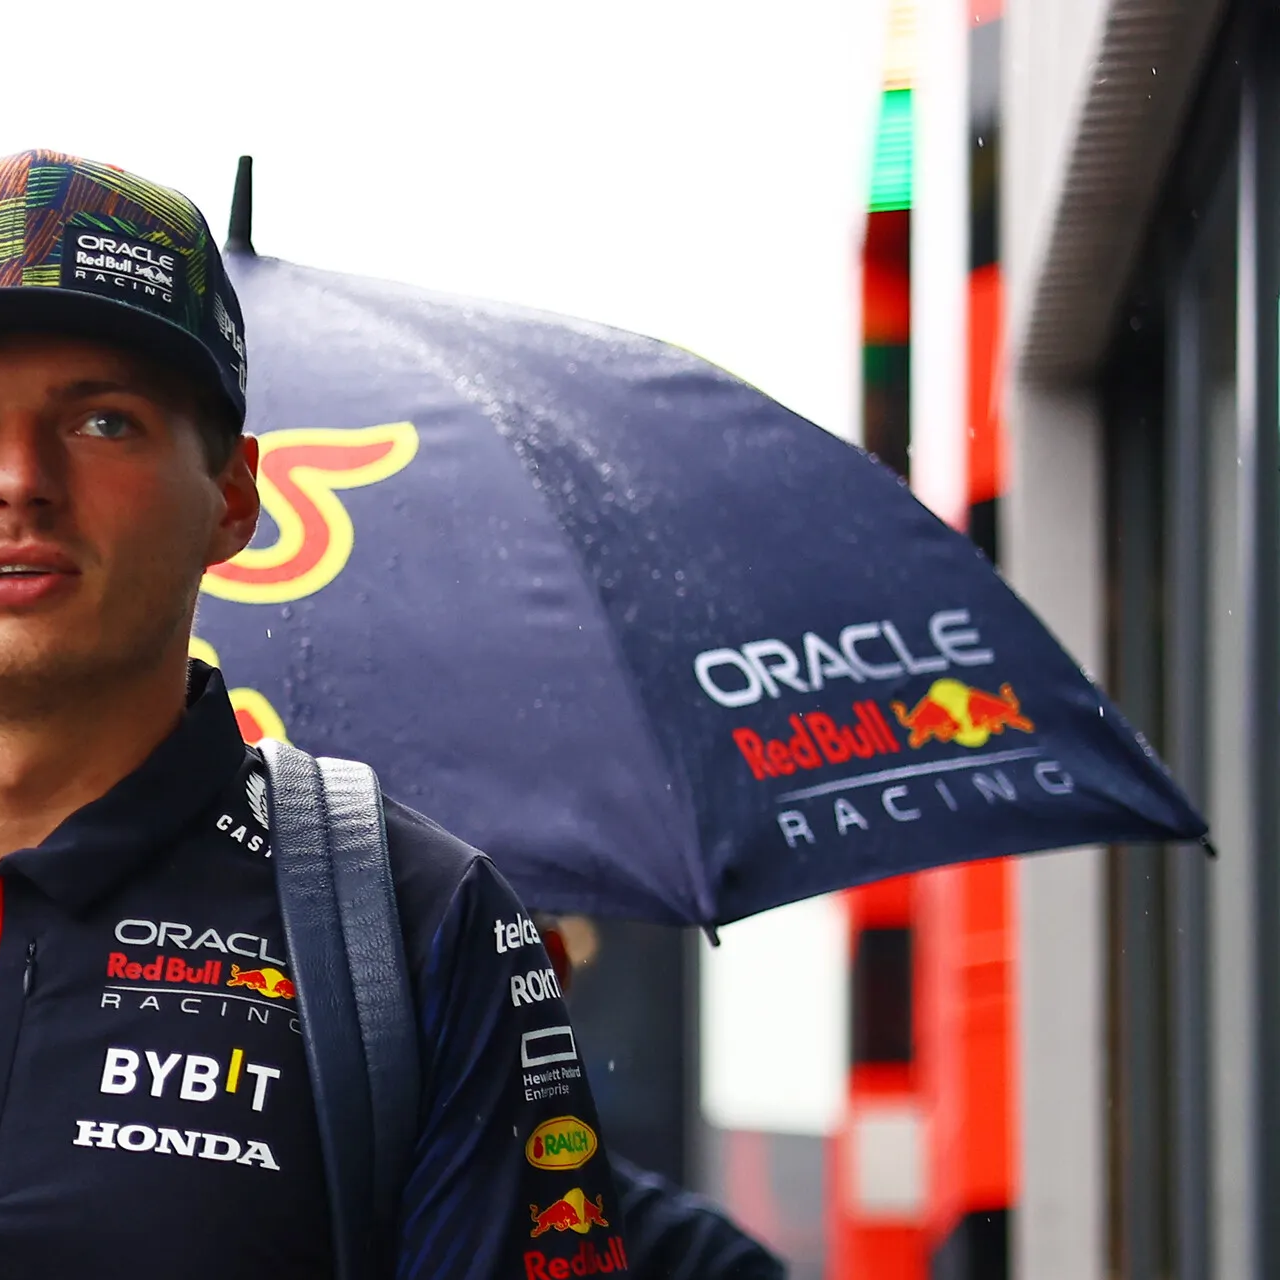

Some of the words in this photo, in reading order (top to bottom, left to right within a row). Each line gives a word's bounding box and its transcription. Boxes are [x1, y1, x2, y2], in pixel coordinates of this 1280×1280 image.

[77, 234, 175, 271] ORACLE
[75, 270, 172, 303] RACING
[693, 608, 996, 708] ORACLE
[777, 760, 1075, 848] RACING
[113, 918, 287, 967] ORACL
[494, 912, 541, 954] telce
[98, 1046, 281, 1113] BYBIT
[72, 1119, 281, 1172] HONDA
[545, 1131, 589, 1156] RAUCH
